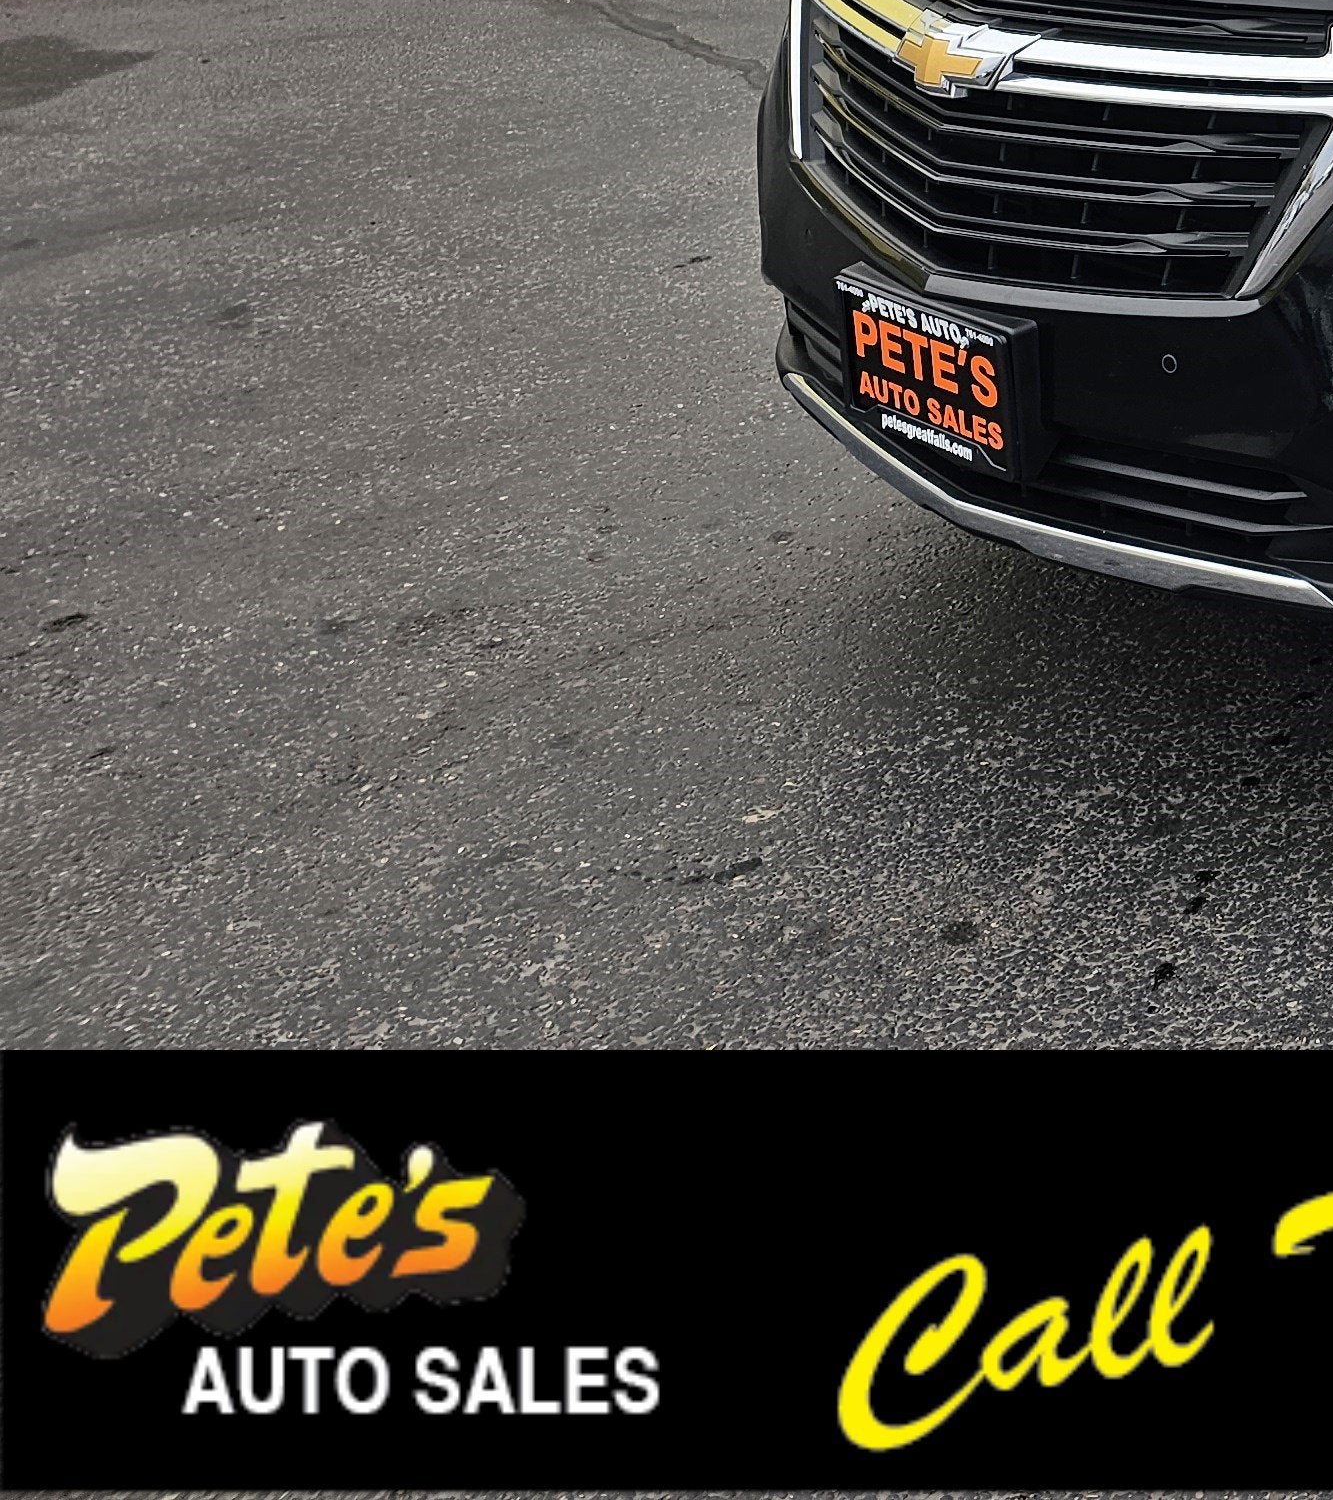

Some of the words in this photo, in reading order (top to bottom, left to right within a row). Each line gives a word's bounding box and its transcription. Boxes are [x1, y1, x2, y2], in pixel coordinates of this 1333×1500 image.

[867, 292, 918, 329] PETE'S
[920, 313, 962, 345] AUTO
[852, 309, 998, 408] PETE'S
[859, 370, 921, 417] AUTO
[927, 396, 1005, 451] SALES
[881, 411, 974, 462] petesgreatfalls.com
